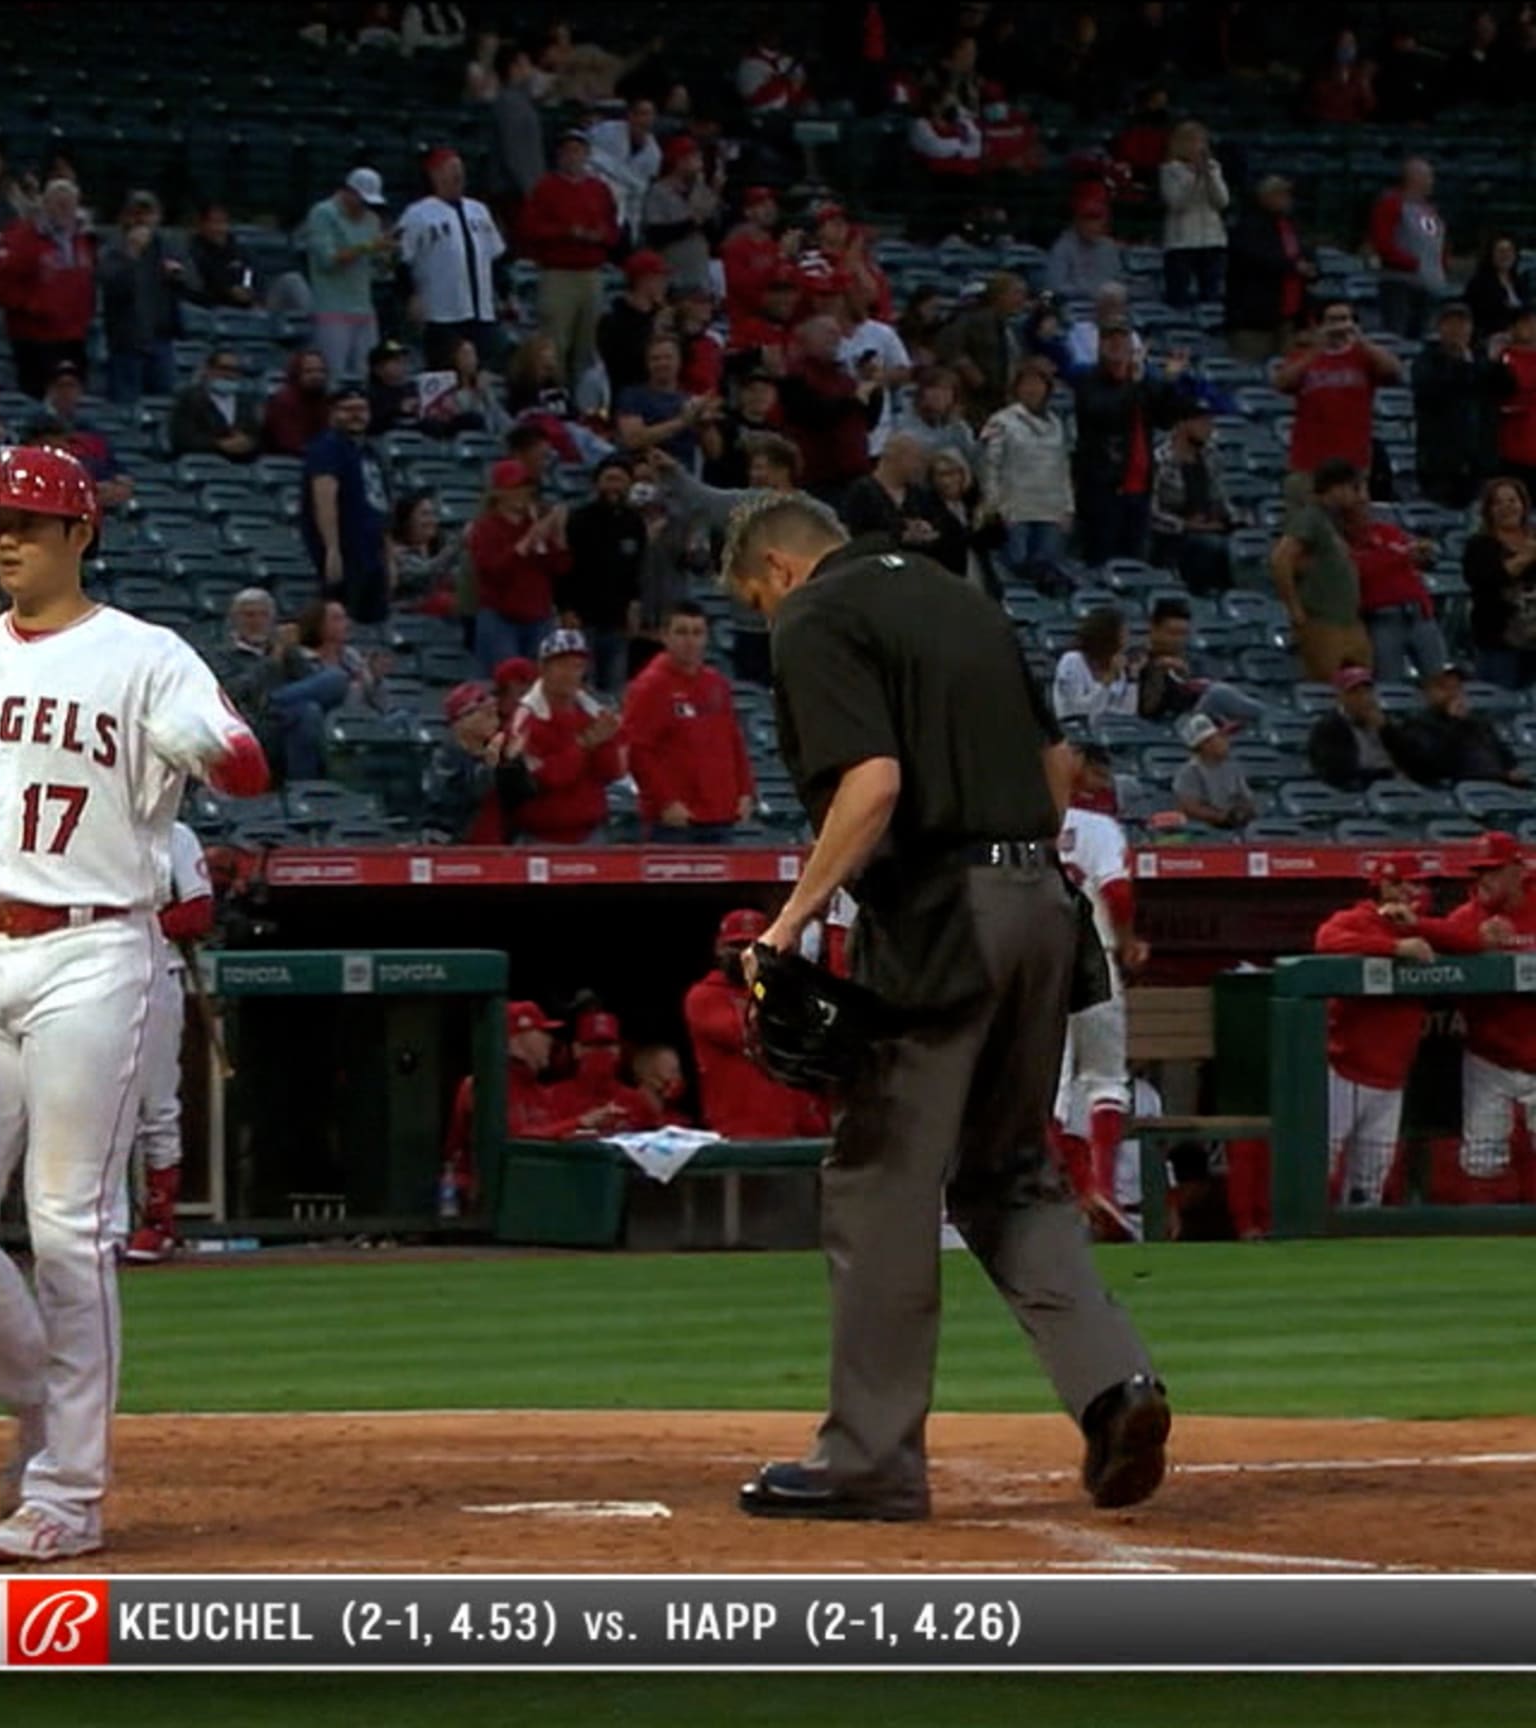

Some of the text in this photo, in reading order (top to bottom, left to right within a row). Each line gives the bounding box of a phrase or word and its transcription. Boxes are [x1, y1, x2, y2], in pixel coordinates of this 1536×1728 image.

[20, 782, 90, 854] 17
[221, 966, 293, 984] TOYOTA
[377, 964, 448, 983] TOYOTA
[1398, 965, 1465, 984] TOYOTA
